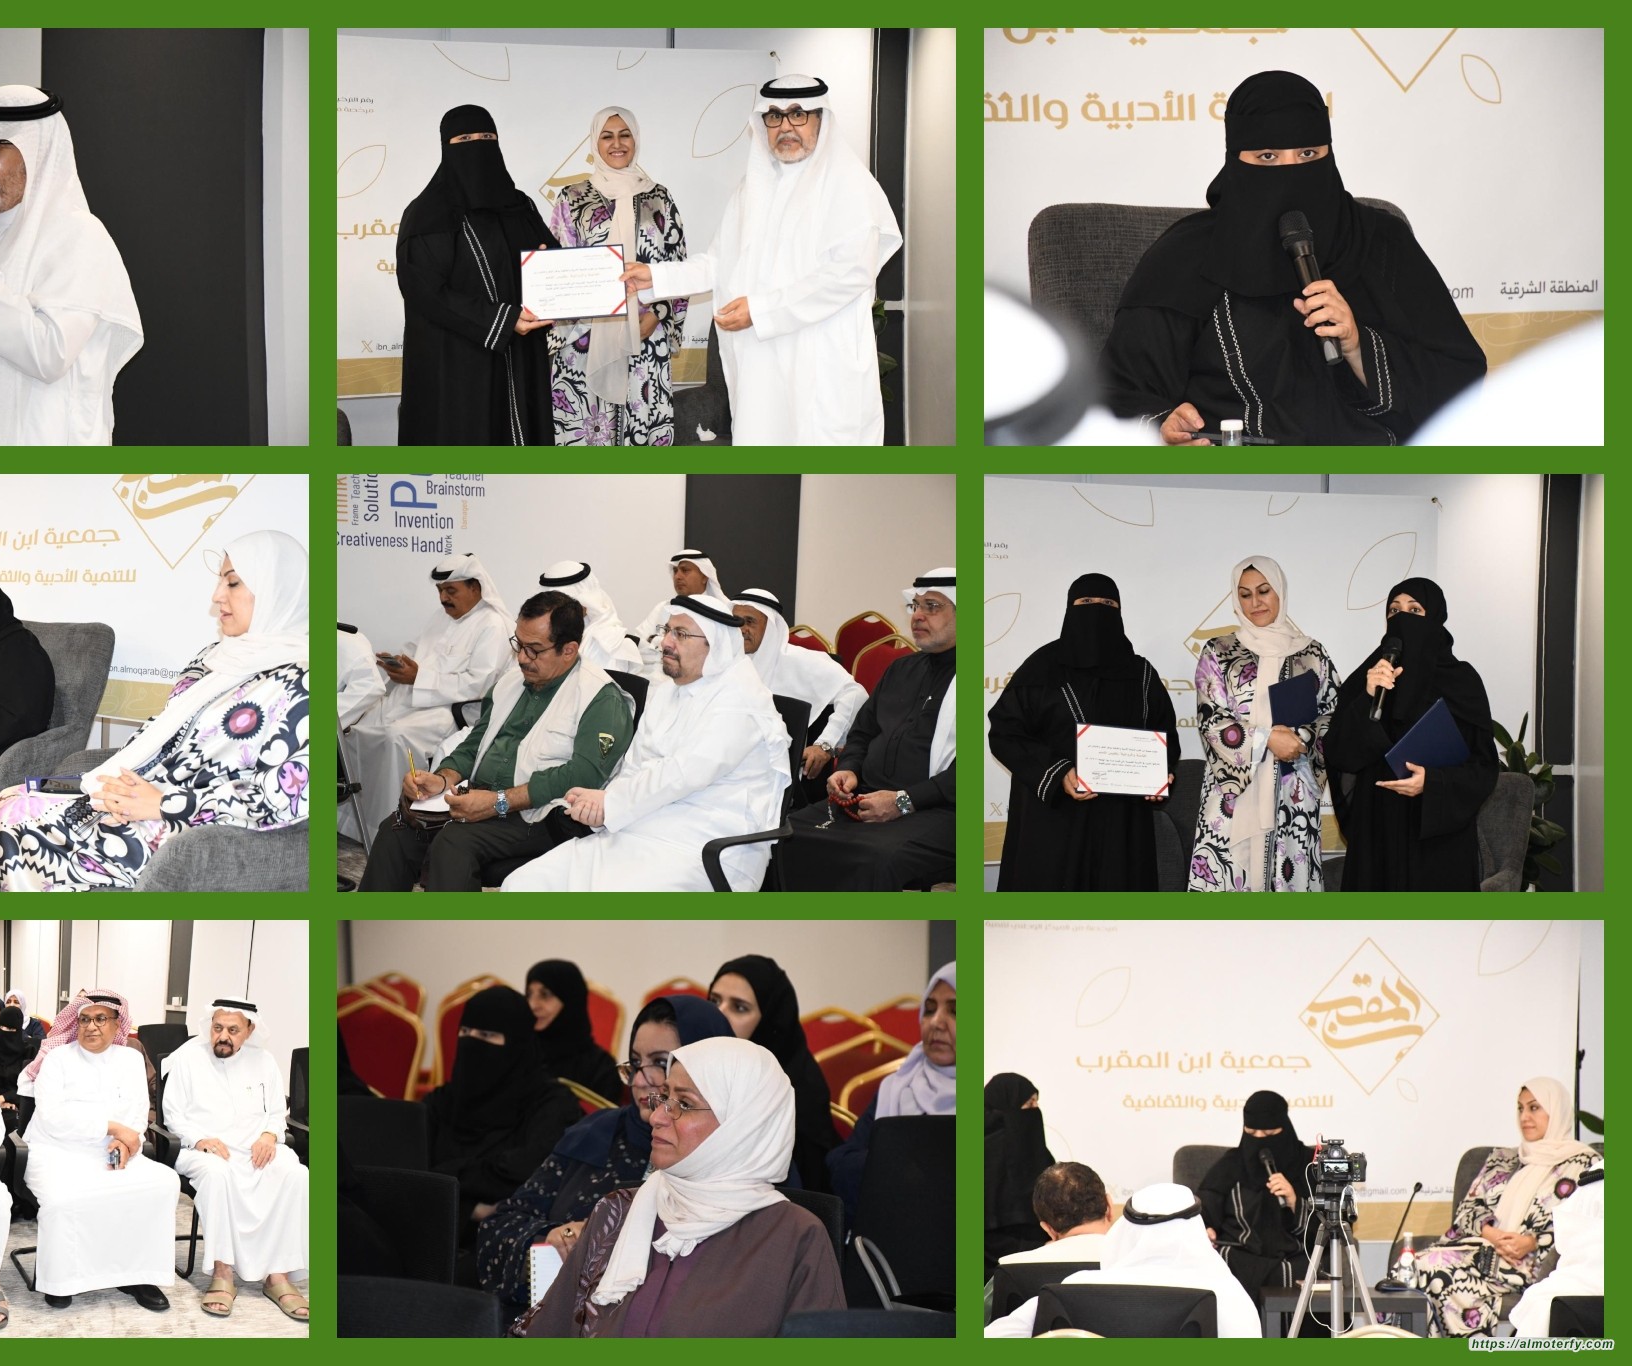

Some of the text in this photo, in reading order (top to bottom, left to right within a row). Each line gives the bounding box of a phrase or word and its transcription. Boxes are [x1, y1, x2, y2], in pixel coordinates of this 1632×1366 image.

[1081, 90, 1197, 130] الأدبية
[337, 219, 401, 240] مقرب
[377, 259, 396, 275] ية
[1449, 286, 1474, 299] om
[1500, 279, 1598, 300] المنطقة الشرقية
[390, 474, 438, 509] P
[426, 480, 485, 497] Brainstorm
[394, 511, 454, 529] Invention
[13, 529, 39, 551] ابن
[44, 527, 121, 549] جمعية
[337, 531, 408, 548] reativeness
[411, 536, 444, 553] Hand
[444, 535, 452, 555] Work
[35, 568, 78, 586] الأدبية
[82, 568, 137, 586] للتنمية
[1075, 1050, 1312, 1074] جمعية ابن المقرب
[1122, 1094, 1207, 1112] والثقافية
[1288, 1095, 1334, 1109] للتنم
